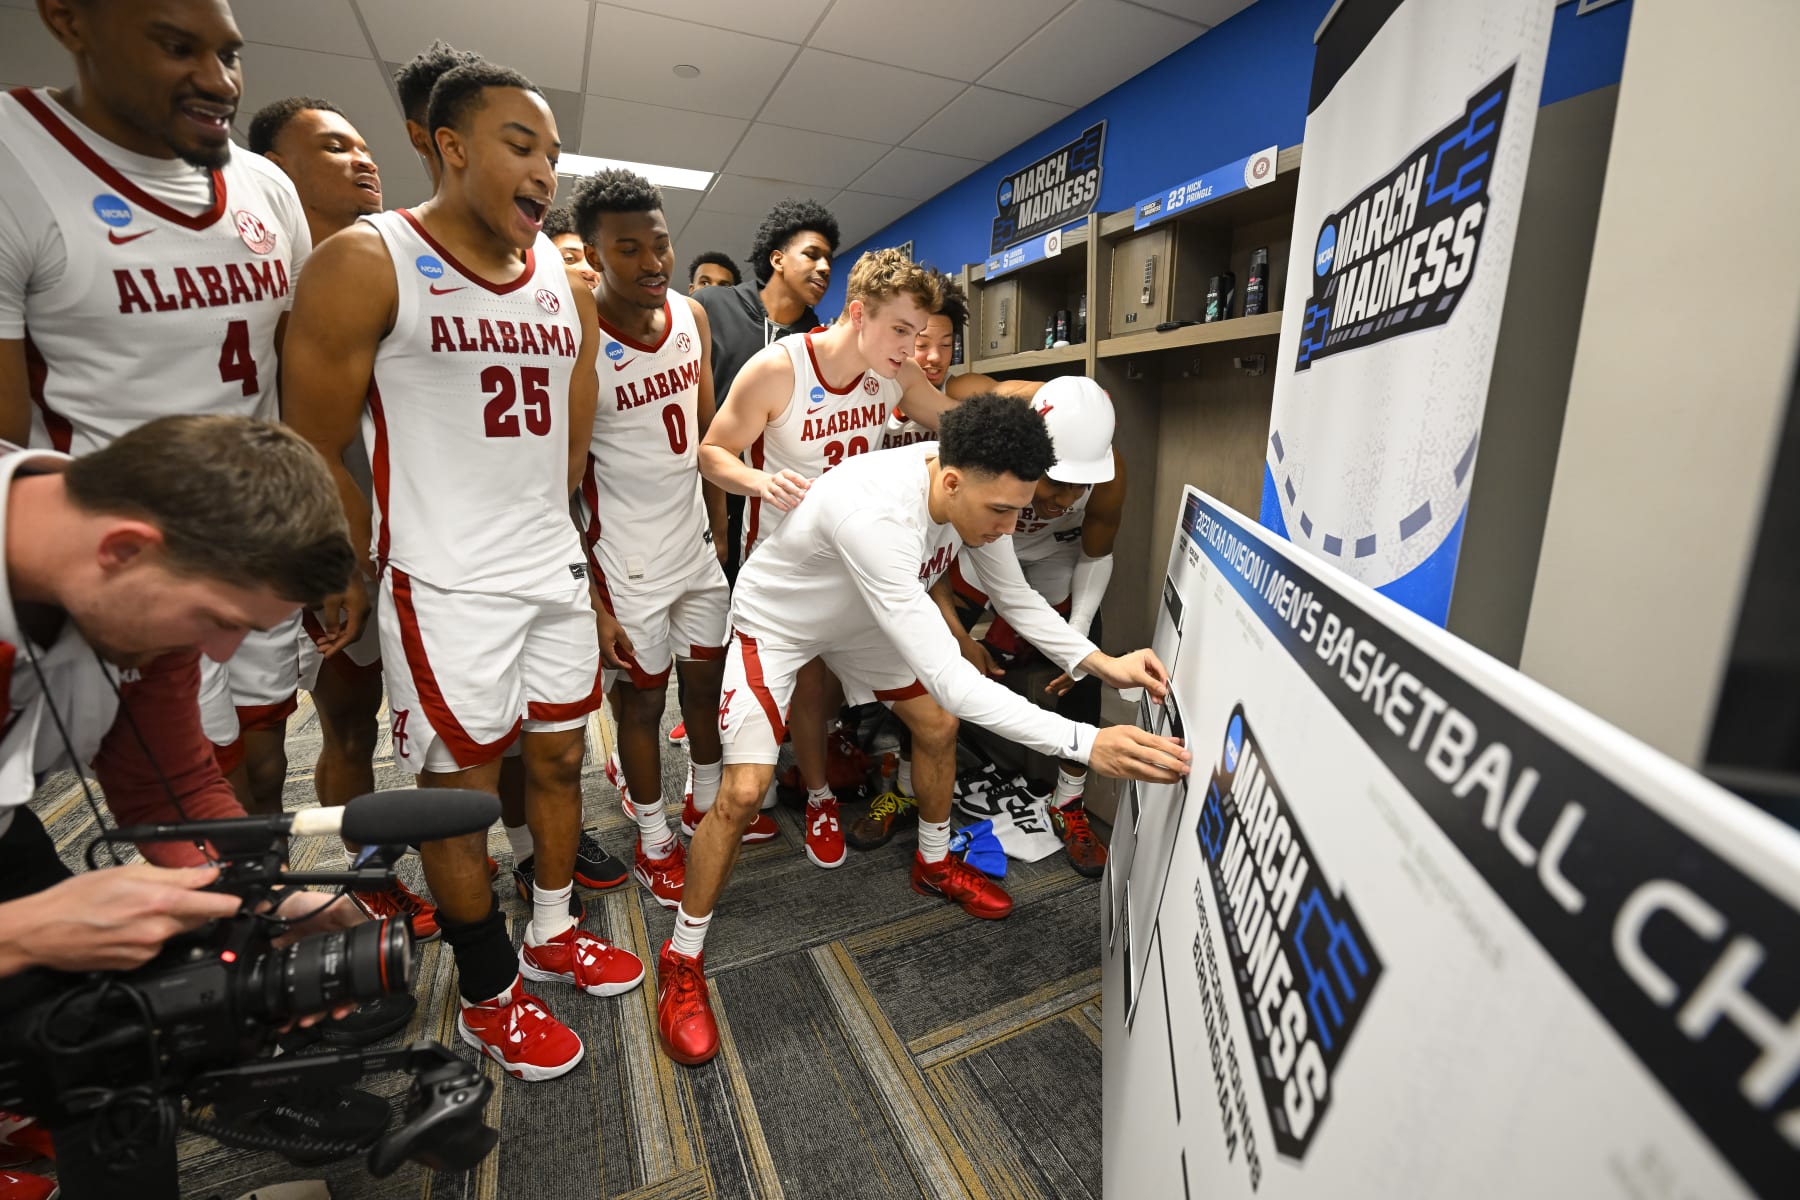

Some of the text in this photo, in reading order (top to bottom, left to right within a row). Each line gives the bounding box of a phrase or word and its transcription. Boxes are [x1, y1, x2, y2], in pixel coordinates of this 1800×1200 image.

[1012, 151, 1068, 205] MARCH
[1018, 169, 1097, 229] MADNESS
[1167, 186, 1186, 211] 23
[1186, 180, 1202, 194] NICK
[1186, 185, 1213, 204] PRINGLE
[101, 209, 131, 219] NCAA
[1332, 153, 1428, 275] MARCH
[420, 262, 442, 274] NCAA
[1317, 246, 1334, 266] NCAA
[1331, 201, 1483, 331] MADNESS
[112, 259, 289, 314] ALABAMA
[218, 320, 259, 397] 4
[431, 316, 576, 358] ALABAMA
[480, 365, 551, 437] 25
[615, 359, 700, 411] ALABAMA
[662, 403, 687, 455] 0
[800, 402, 886, 441] ALABAMA
[1196, 510, 1211, 538] 2023
[1207, 519, 1227, 554] NCAA
[1223, 533, 1265, 589] DIVISION
[1259, 563, 1270, 595] I
[1264, 569, 1323, 643] MEN'S
[1315, 612, 1587, 915] BASKETBALL
[1230, 738, 1309, 931] MARCH
[1219, 817, 1327, 1141] MADNESS
[1611, 877, 1800, 1150] CH
[1193, 930, 1238, 1165] BIRMINGHAM
[1227, 1035, 1262, 1194] ROUNDS
